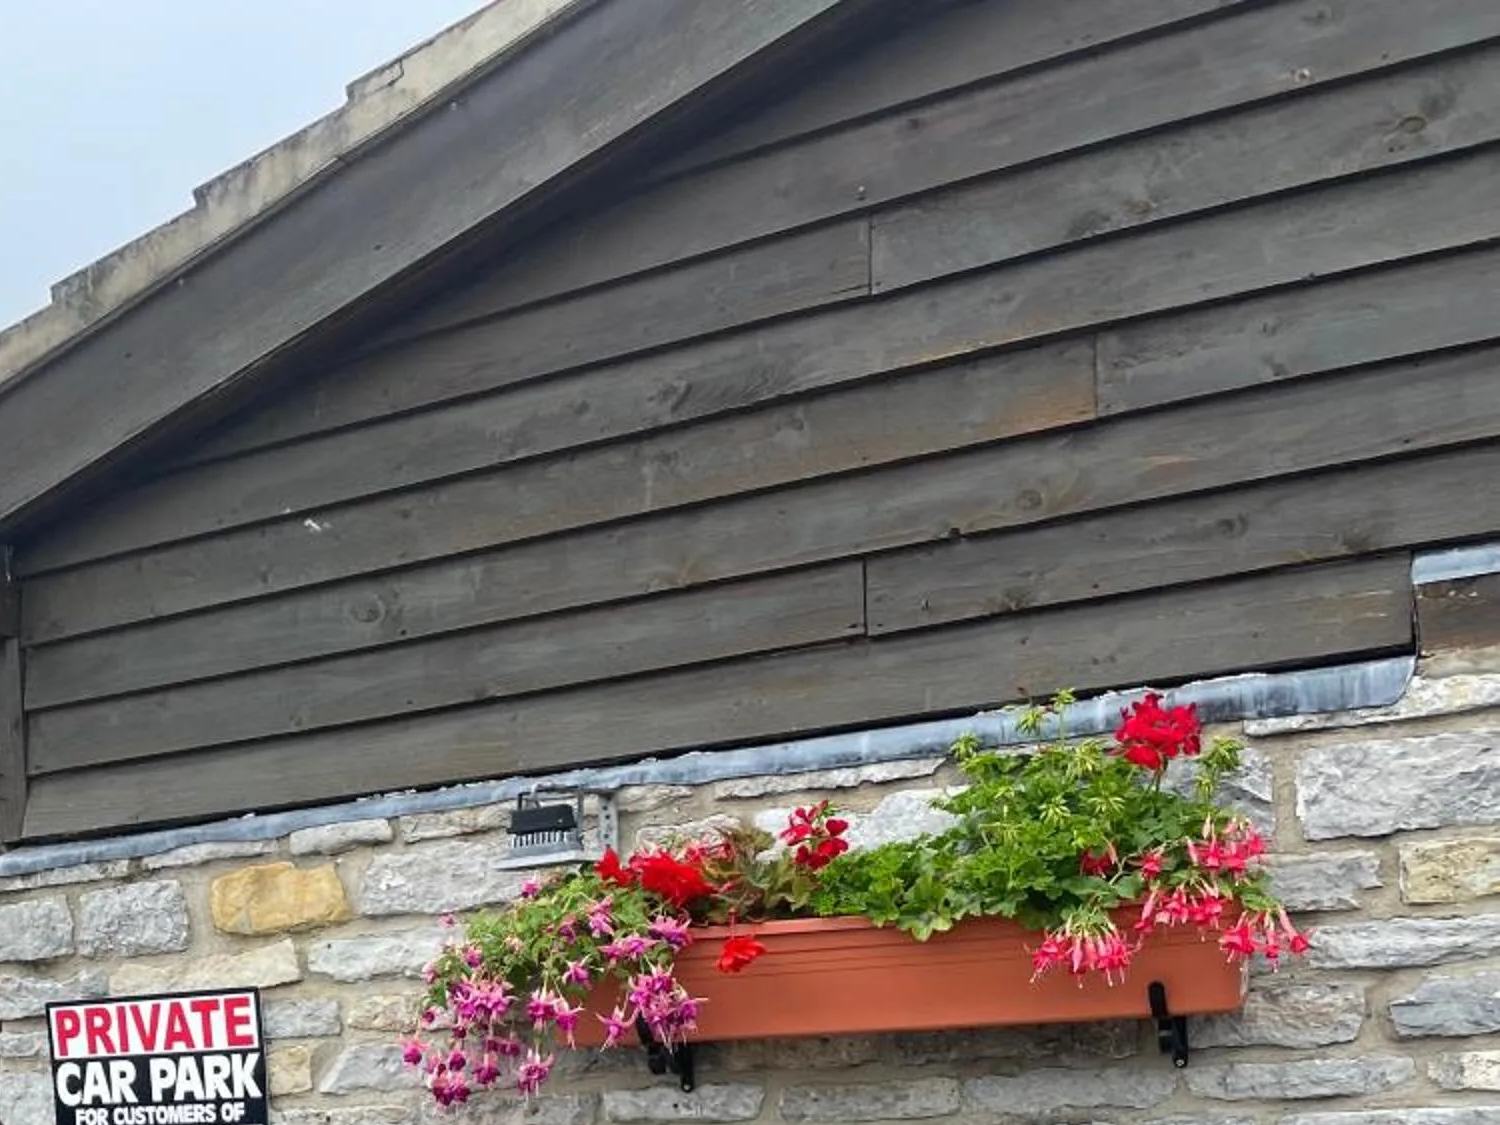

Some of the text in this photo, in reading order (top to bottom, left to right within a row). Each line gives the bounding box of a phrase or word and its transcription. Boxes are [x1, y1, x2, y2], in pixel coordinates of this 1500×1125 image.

[55, 996, 255, 1057] PRIVATE
[56, 1052, 263, 1106] CAR PARK
[113, 1103, 216, 1125] CUSTOMERS
[221, 1102, 245, 1122] OF
